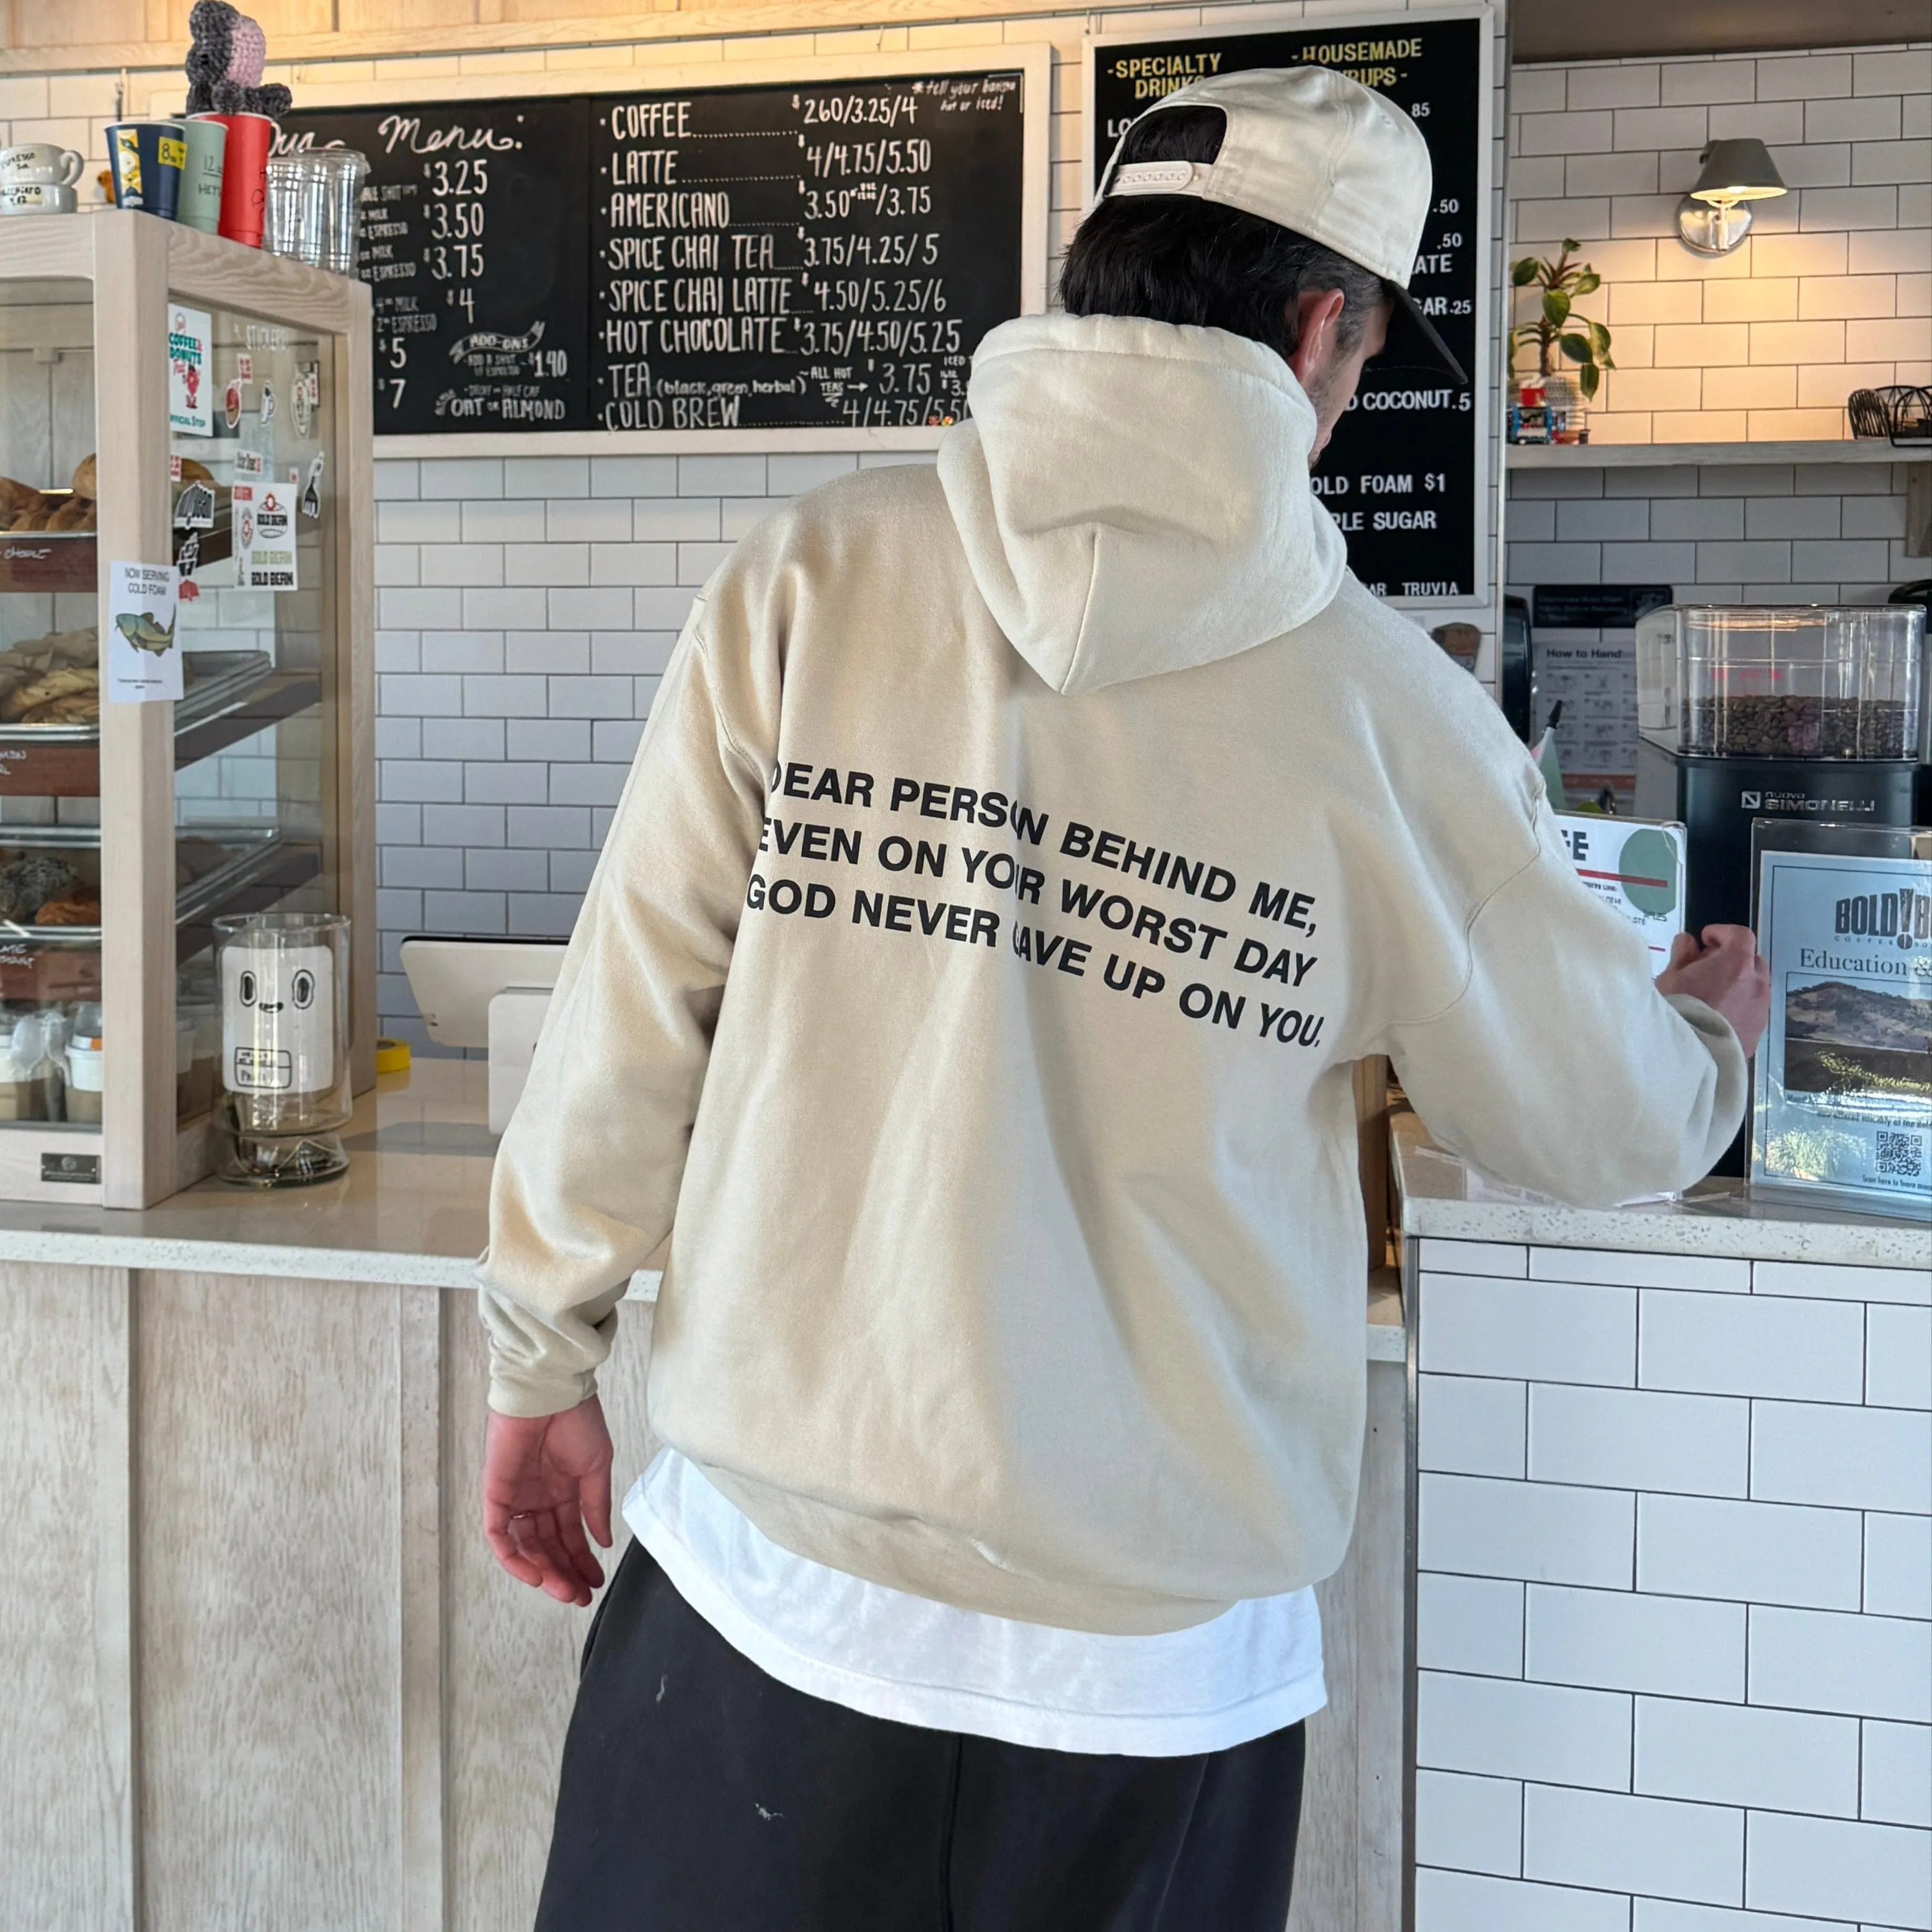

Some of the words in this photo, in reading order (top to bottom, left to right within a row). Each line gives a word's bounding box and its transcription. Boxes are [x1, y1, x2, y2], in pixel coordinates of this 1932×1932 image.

[611, 101, 692, 140] COFFEE
[423, 159, 488, 196] $3.25
[613, 149, 679, 186] LATTE
[423, 202, 485, 240] $3.50
[610, 192, 730, 229] AMERICANO
[1432, 198, 1459, 214] .50
[608, 236, 666, 272] SPICE
[672, 235, 720, 272] CHAI
[731, 234, 774, 271] TEA
[1437, 232, 1463, 251] .50
[423, 244, 485, 280] $3.75
[1412, 253, 1453, 274] ATE
[446, 288, 475, 324] $4
[609, 279, 668, 313] SPICE
[673, 276, 724, 316] CHAI
[732, 277, 792, 315] LATTE
[169, 332, 197, 350] COFFEE
[378, 336, 407, 369] $5
[606, 319, 653, 355] HOT
[660, 316, 787, 354] CHOCOLATE
[944, 355, 966, 367] ICED
[377, 377, 406, 409] $7
[608, 361, 651, 398] TEA
[450, 398, 485, 416] OAT
[501, 398, 566, 422] ALMOND
[605, 398, 664, 431] COLD
[672, 395, 741, 429] BREW
[1310, 476, 1350, 495] OLD
[1360, 474, 1413, 494] FOAM
[1424, 473, 1445, 493] $1
[1372, 510, 1437, 531] SUGAR
[1401, 581, 1460, 596] TRUVIA
[1547, 648, 1573, 659] How
[1576, 648, 1587, 659] to
[1765, 791, 1805, 799] nuova
[1765, 798, 1876, 812] SIMONELLI
[771, 761, 875, 808] EAR
[1060, 821, 1237, 903] BEHIND
[1248, 881, 1317, 938] ME,
[759, 817, 862, 866] EVEN
[878, 836, 947, 878] ON
[961, 847, 1045, 905] YOR
[1061, 878, 1229, 961] WORST
[1233, 938, 1319, 987] DAY
[746, 874, 836, 919] GOD
[851, 889, 1000, 949] NEVER
[1103, 952, 1166, 1000] UP
[1179, 982, 1247, 1030] ON
[1800, 947, 1907, 977] Education
